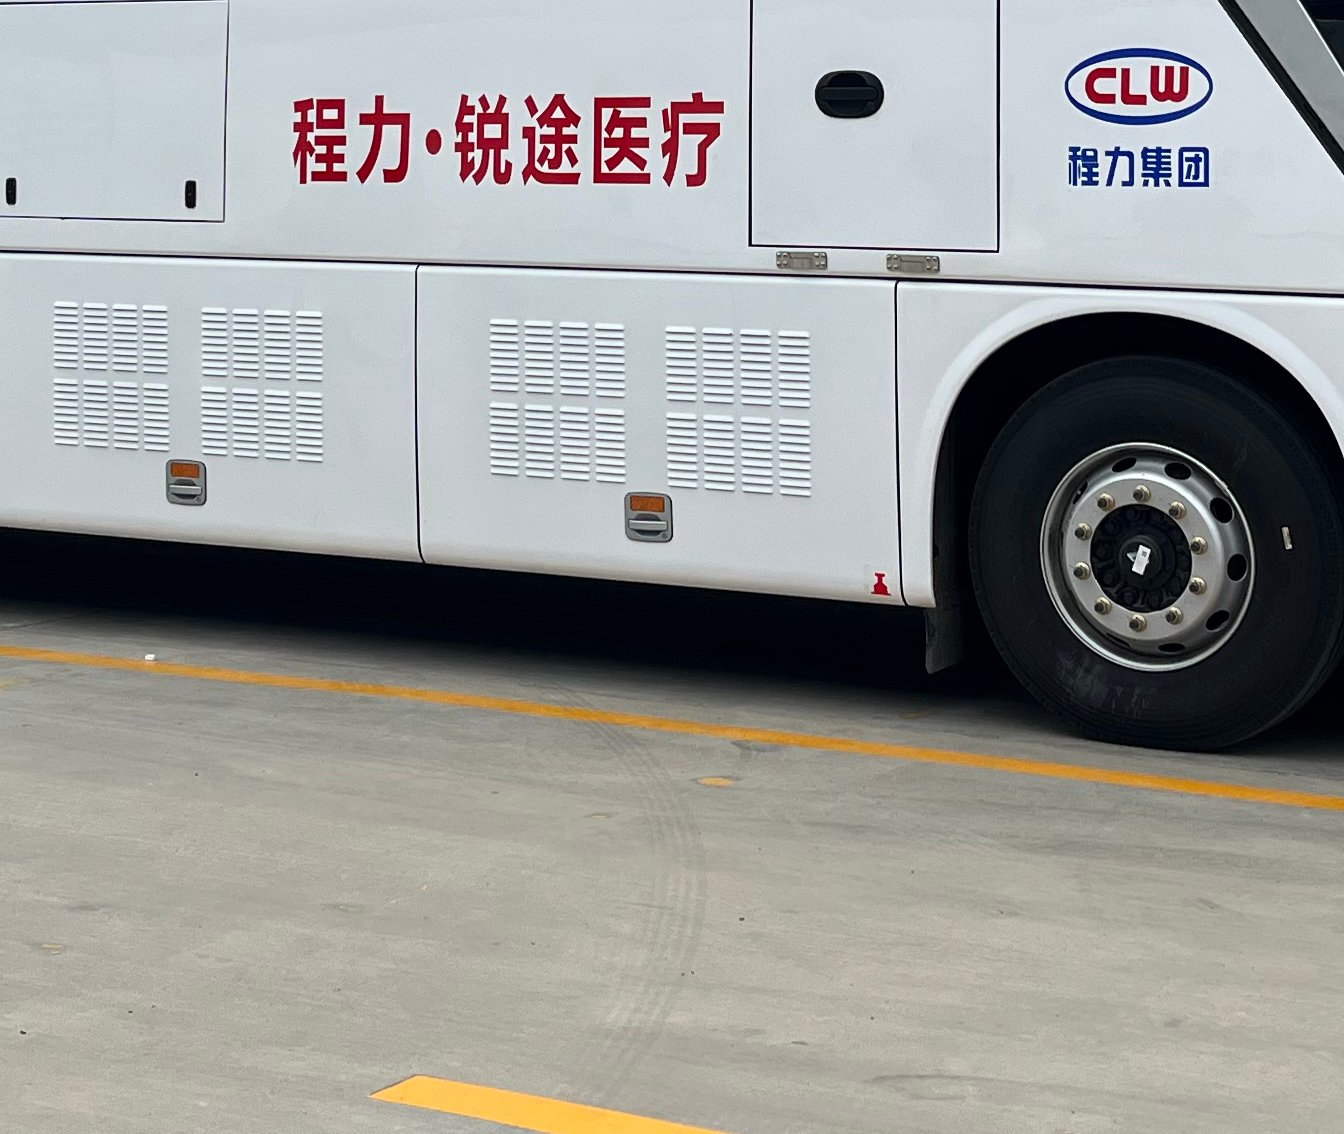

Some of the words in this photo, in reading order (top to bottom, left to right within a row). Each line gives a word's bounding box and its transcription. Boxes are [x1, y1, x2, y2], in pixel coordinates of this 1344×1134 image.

[1085, 65, 1189, 105] CLW
[292, 92, 725, 188] 程力·锐途医疗
[1068, 146, 1210, 187] 程力集团
